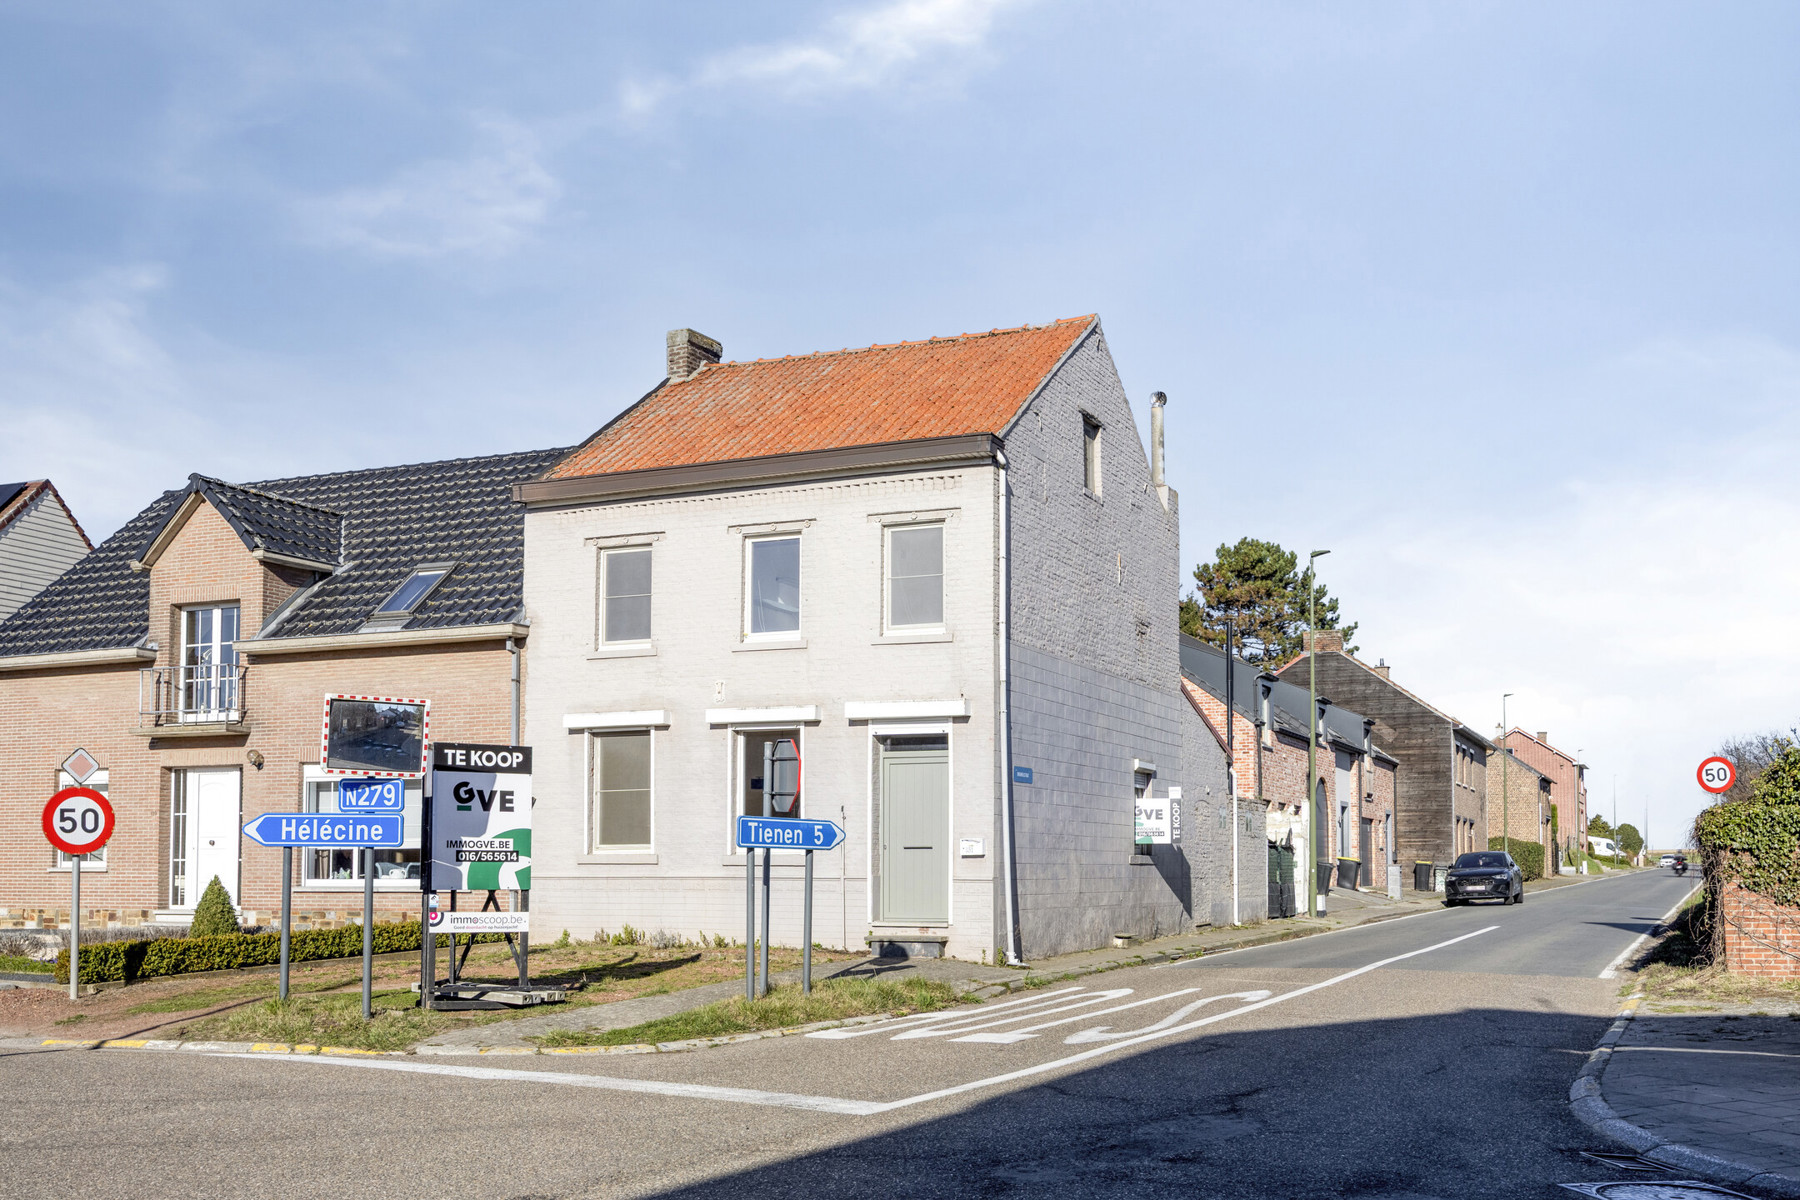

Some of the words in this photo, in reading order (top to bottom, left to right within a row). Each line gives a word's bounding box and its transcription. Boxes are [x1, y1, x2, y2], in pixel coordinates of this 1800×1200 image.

[444, 749, 467, 766] TE
[470, 750, 524, 768] KOOP
[1705, 767, 1727, 782] 50
[346, 784, 396, 806] N279
[453, 781, 515, 812] GVE
[59, 808, 99, 834] 50
[1172, 803, 1181, 827] KOOP
[281, 818, 384, 841] Hélécine
[747, 822, 803, 844] Tienen
[814, 825, 824, 845] 5
[1172, 828, 1181, 839] TE
[446, 840, 510, 849] IMMOGVE.BE
[458, 851, 518, 862] 016/565614
[450, 914, 522, 925] immoscoop.be
